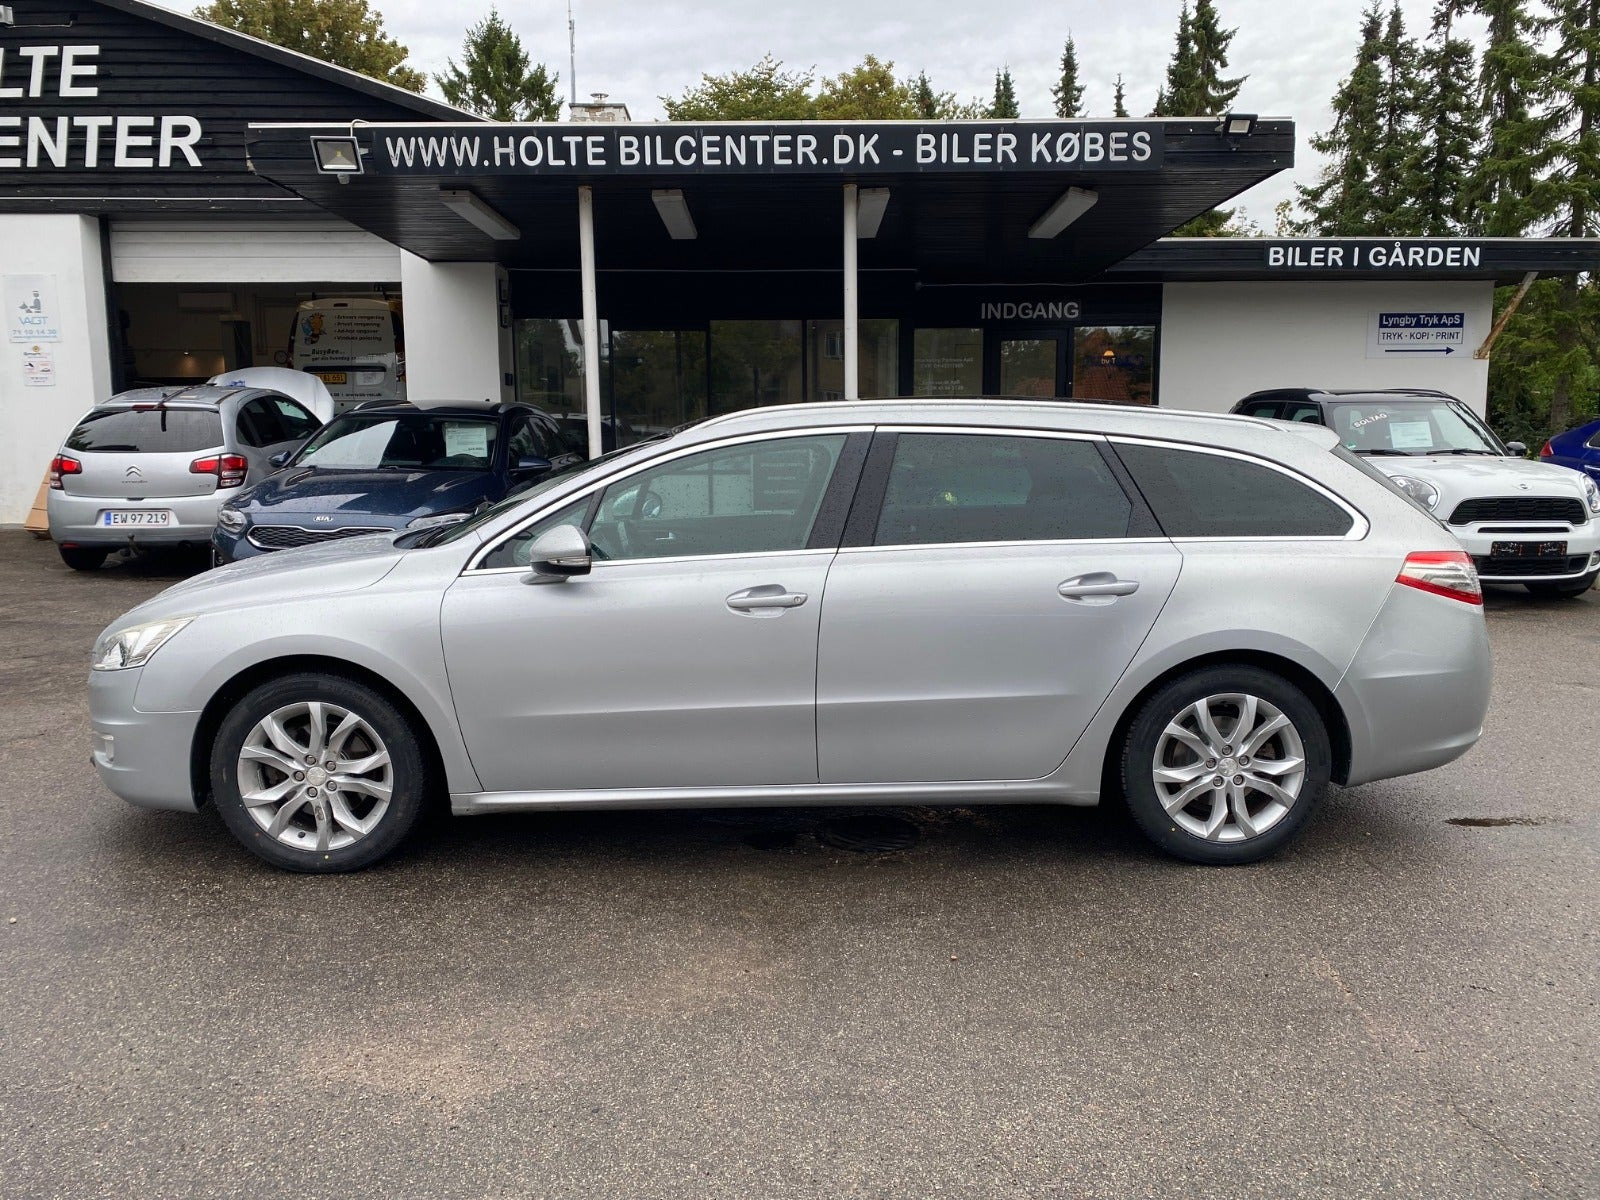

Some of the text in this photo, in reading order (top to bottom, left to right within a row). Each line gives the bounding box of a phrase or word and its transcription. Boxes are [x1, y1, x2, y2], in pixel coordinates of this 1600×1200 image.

[0, 45, 100, 98] LTE
[0, 115, 203, 168] ENTER
[385, 134, 607, 168] WWW.HOLTE
[620, 132, 880, 167] BILCENTER.DK
[916, 132, 1018, 164] BILER
[1031, 130, 1153, 163] KØBES
[1268, 241, 1481, 267] BILER I GÅRDEN
[981, 302, 1080, 320] INDGANG
[1382, 315, 1461, 327] Lyngby Tryk ApS
[1381, 331, 1461, 340] TRYK KOPI PRINT
[1353, 412, 1388, 428] SOLTAG
[113, 513, 167, 524] EW 97 219
